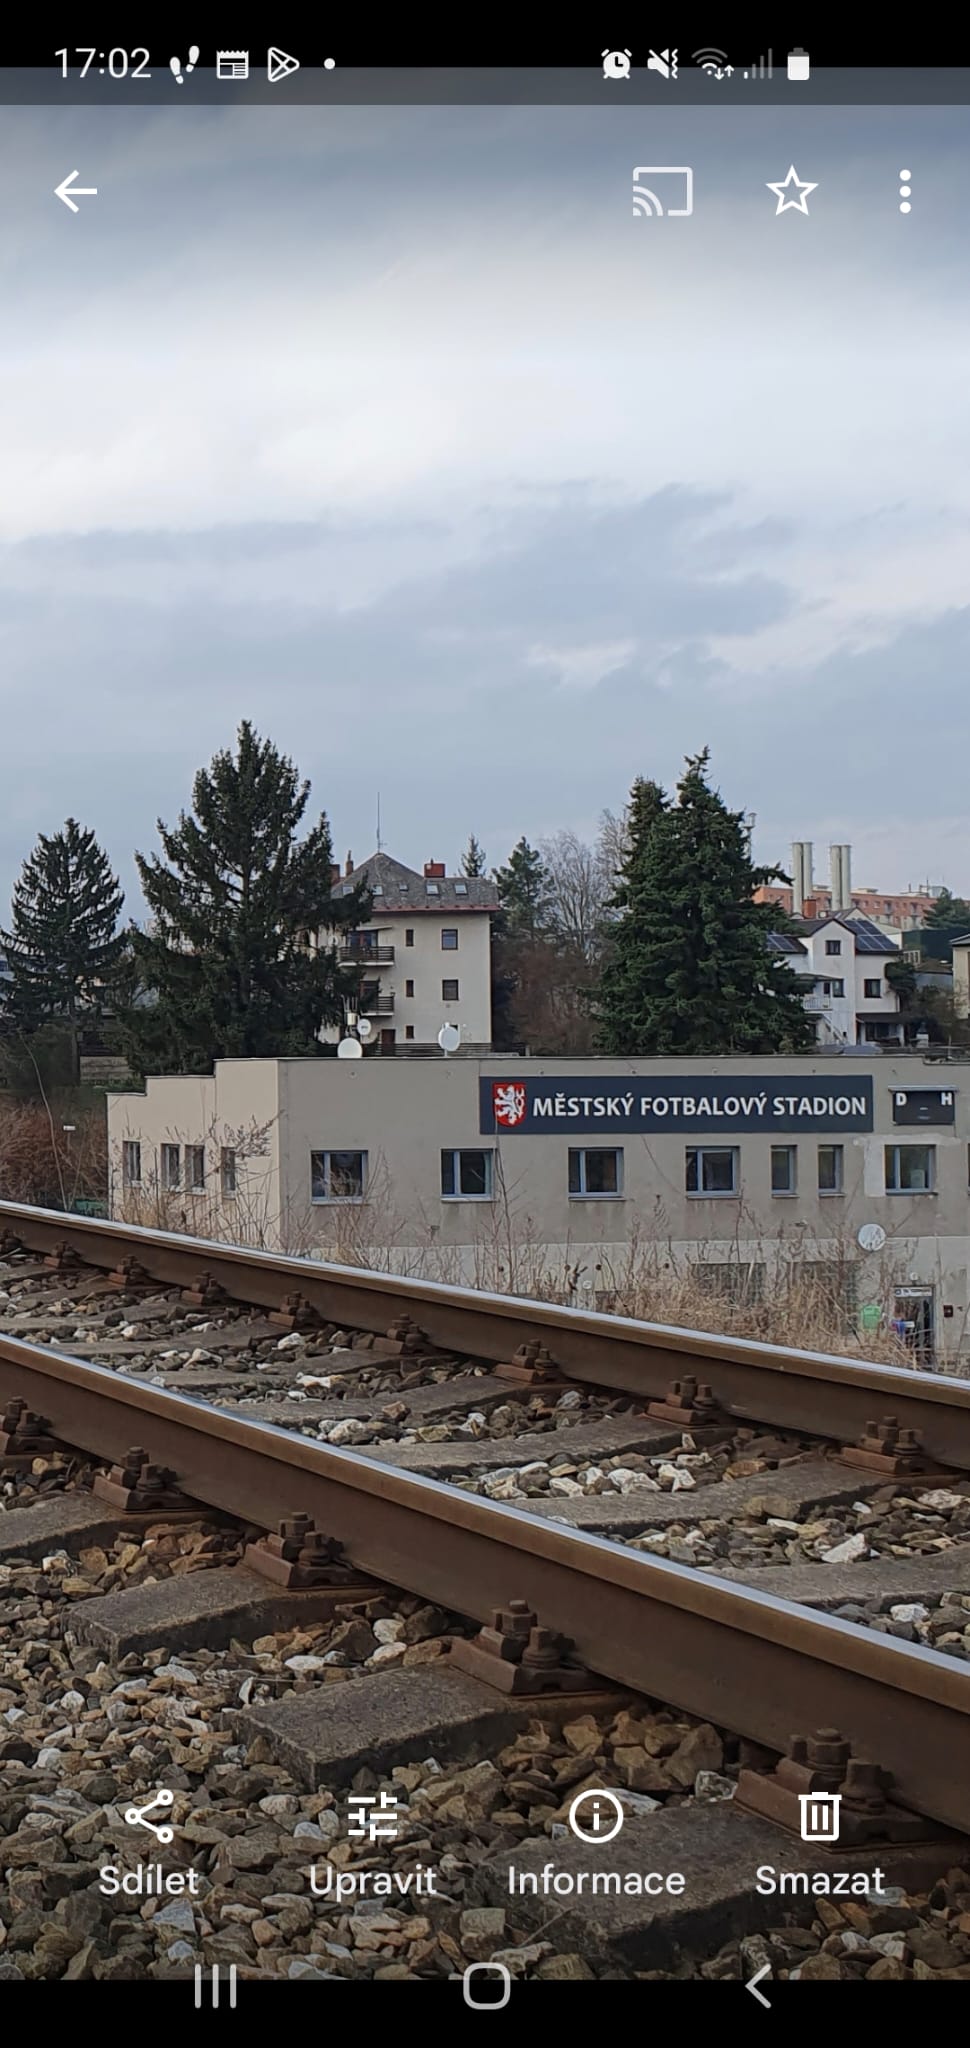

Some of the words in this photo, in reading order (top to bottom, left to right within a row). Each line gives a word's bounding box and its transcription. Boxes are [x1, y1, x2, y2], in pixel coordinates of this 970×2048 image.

[533, 1093, 634, 1117] MĚSTSKÝ
[641, 1092, 767, 1116] FOTBALOVÝ
[773, 1096, 866, 1116] STADION
[896, 1092, 908, 1106] D
[941, 1092, 953, 1106] H
